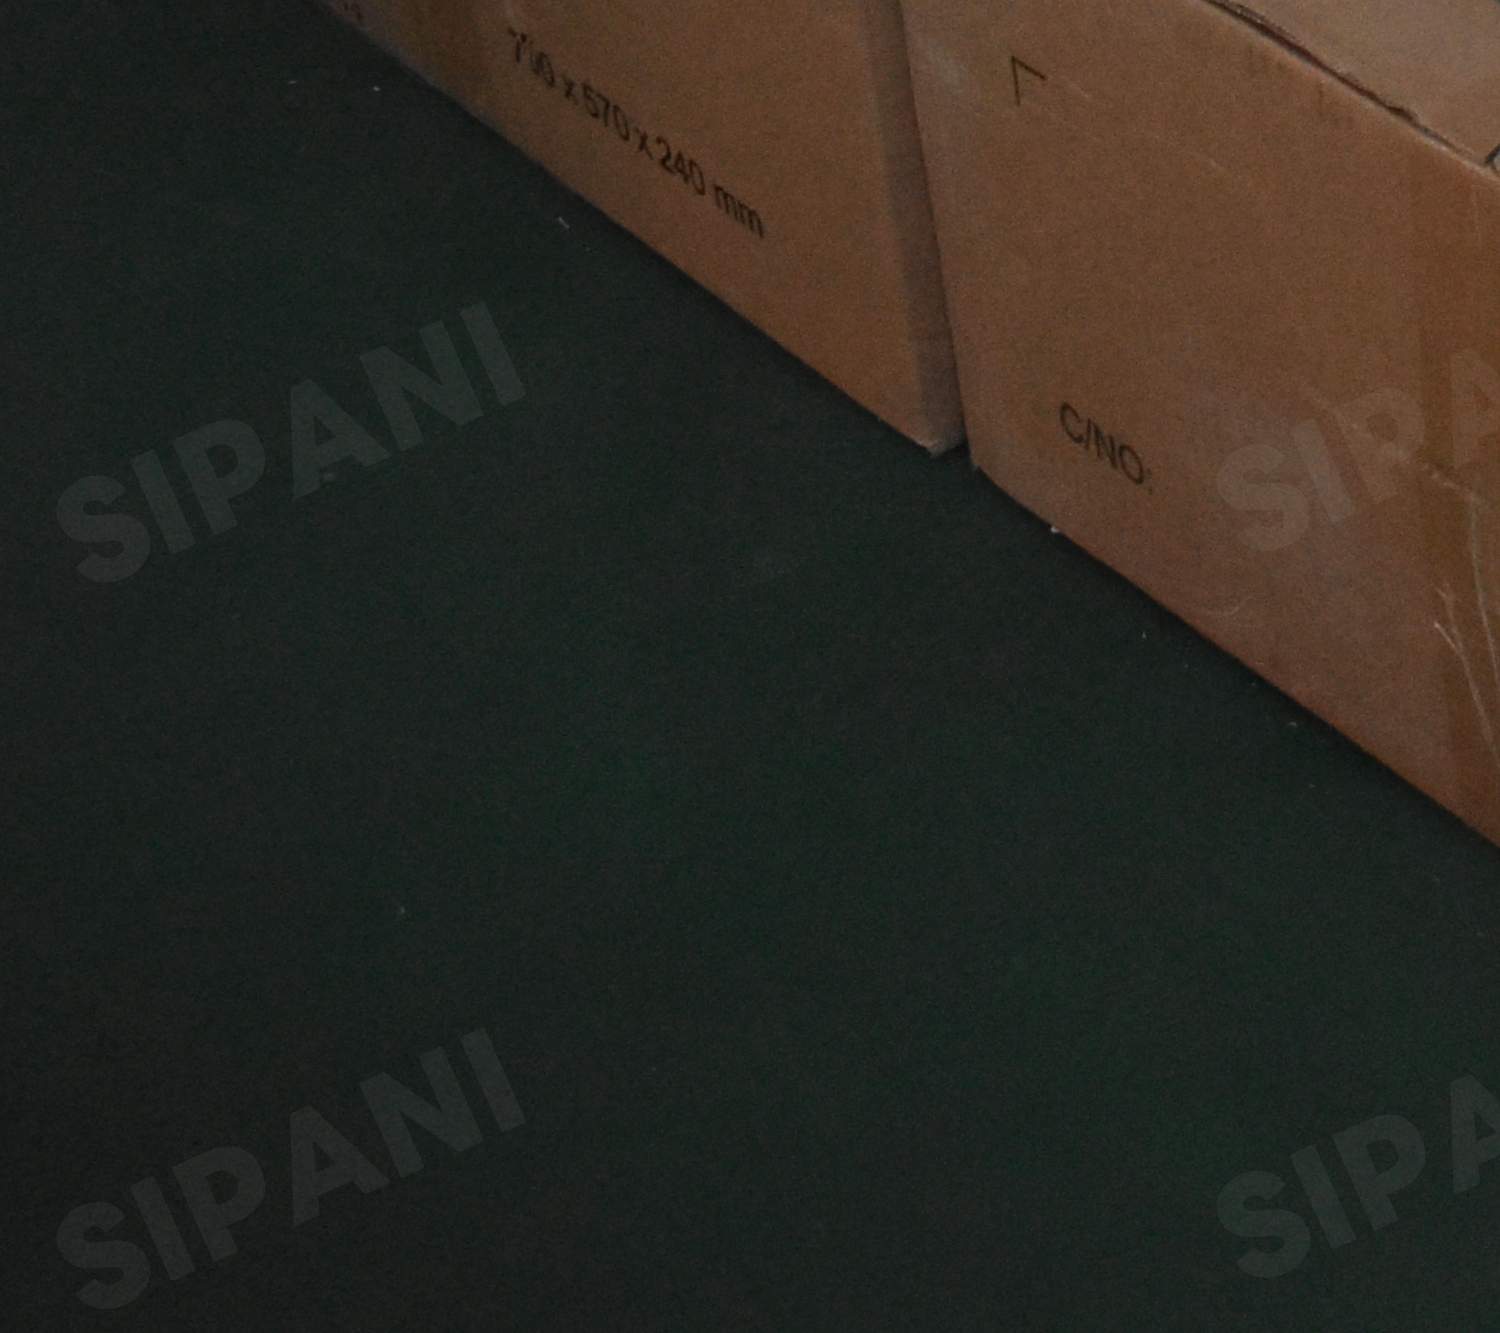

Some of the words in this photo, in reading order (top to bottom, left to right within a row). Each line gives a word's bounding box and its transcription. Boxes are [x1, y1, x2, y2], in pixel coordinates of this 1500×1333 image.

[583, 83, 631, 142] 570
[656, 136, 706, 197] 240
[713, 184, 765, 239] mm
